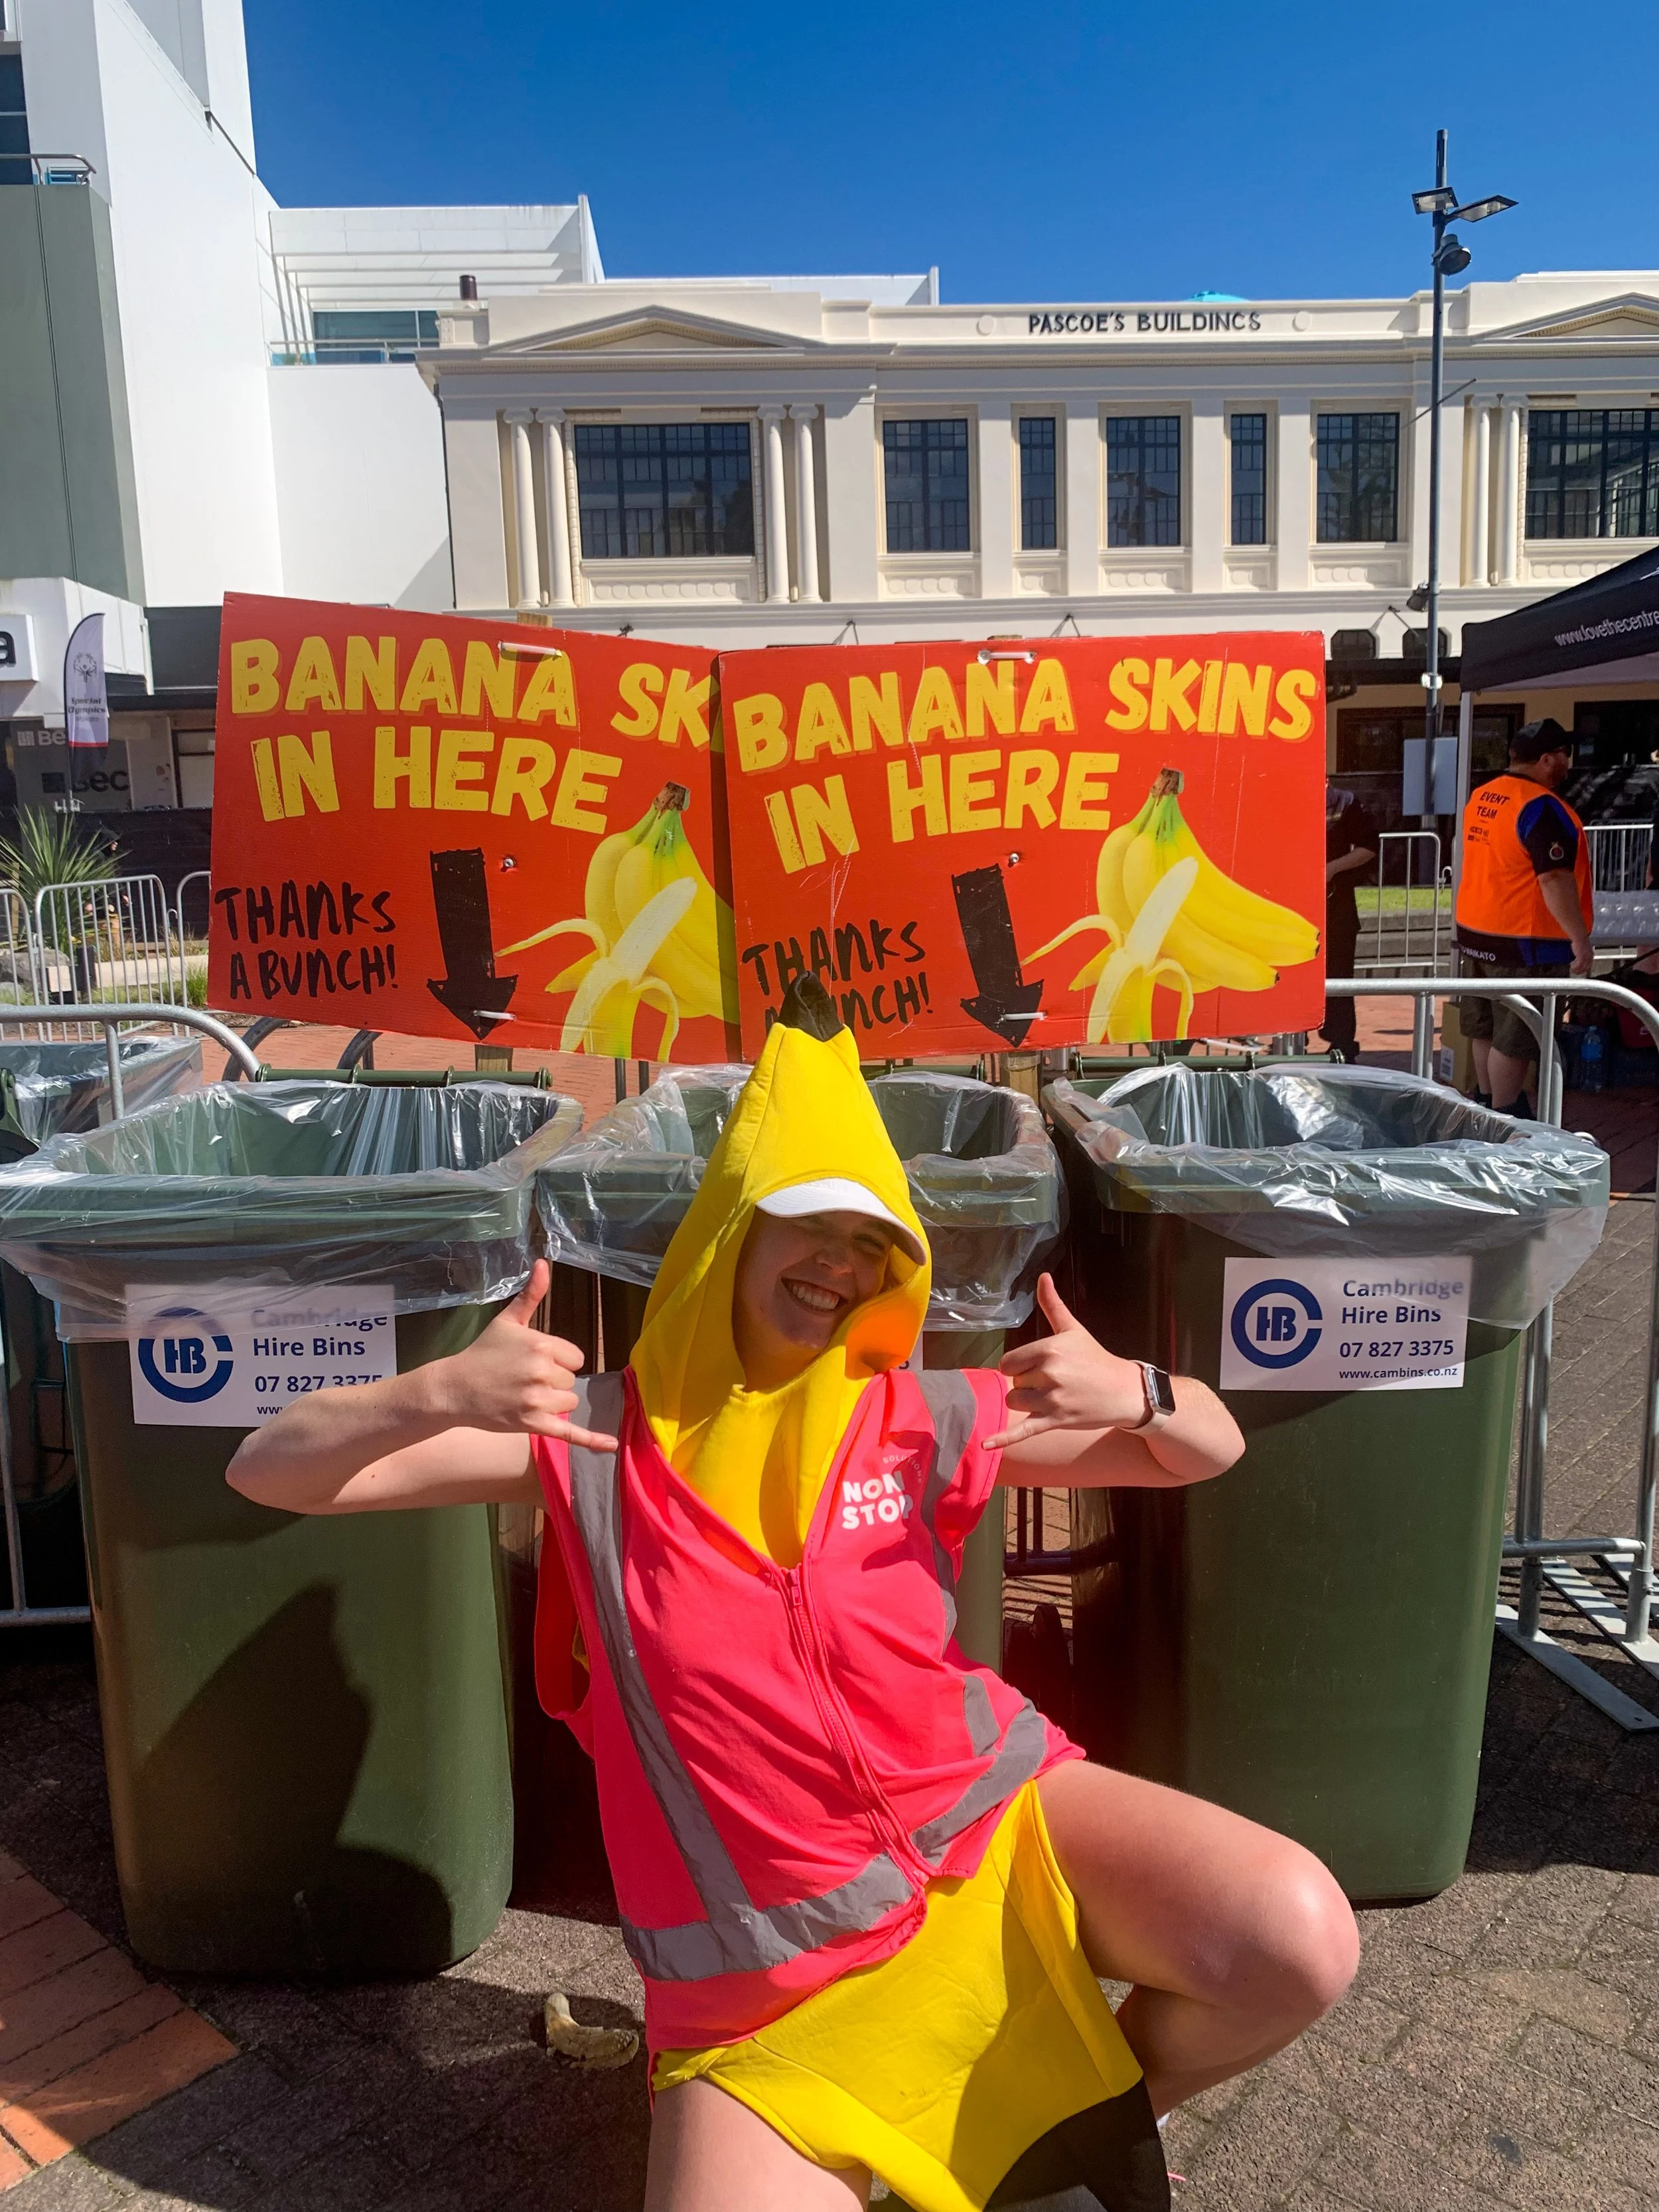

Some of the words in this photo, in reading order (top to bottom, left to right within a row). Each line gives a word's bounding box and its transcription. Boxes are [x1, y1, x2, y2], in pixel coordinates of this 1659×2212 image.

[1029, 313, 1125, 335] PASCOE'S
[231, 635, 578, 726] BANANA
[733, 658, 1076, 774] BANANA
[1105, 658, 1316, 740] SKINS
[251, 730, 340, 822] IN
[374, 725, 622, 834] HERE
[1480, 791, 1510, 806] EVENT
[764, 774, 860, 874] IN
[887, 749, 1119, 844] HERE
[1477, 806, 1498, 819] TEAM
[214, 879, 396, 944] THANKS
[230, 952, 252, 999] A
[1342, 1278, 1464, 1299] Cambridge
[1342, 1307, 1388, 1324] Hire
[1396, 1305, 1441, 1323] Bins
[253, 1338, 304, 1356] Hire
[313, 1337, 366, 1356] Bins
[1340, 1342, 1363, 1357] 07
[1368, 1341, 1404, 1357] 827
[1408, 1339, 1454, 1356] 3375
[1339, 1366, 1457, 1379] www.cambins.co.nz
[255, 1376, 279, 1392] 07
[287, 1376, 325, 1392] 827
[841, 1495, 914, 1530] STOP
